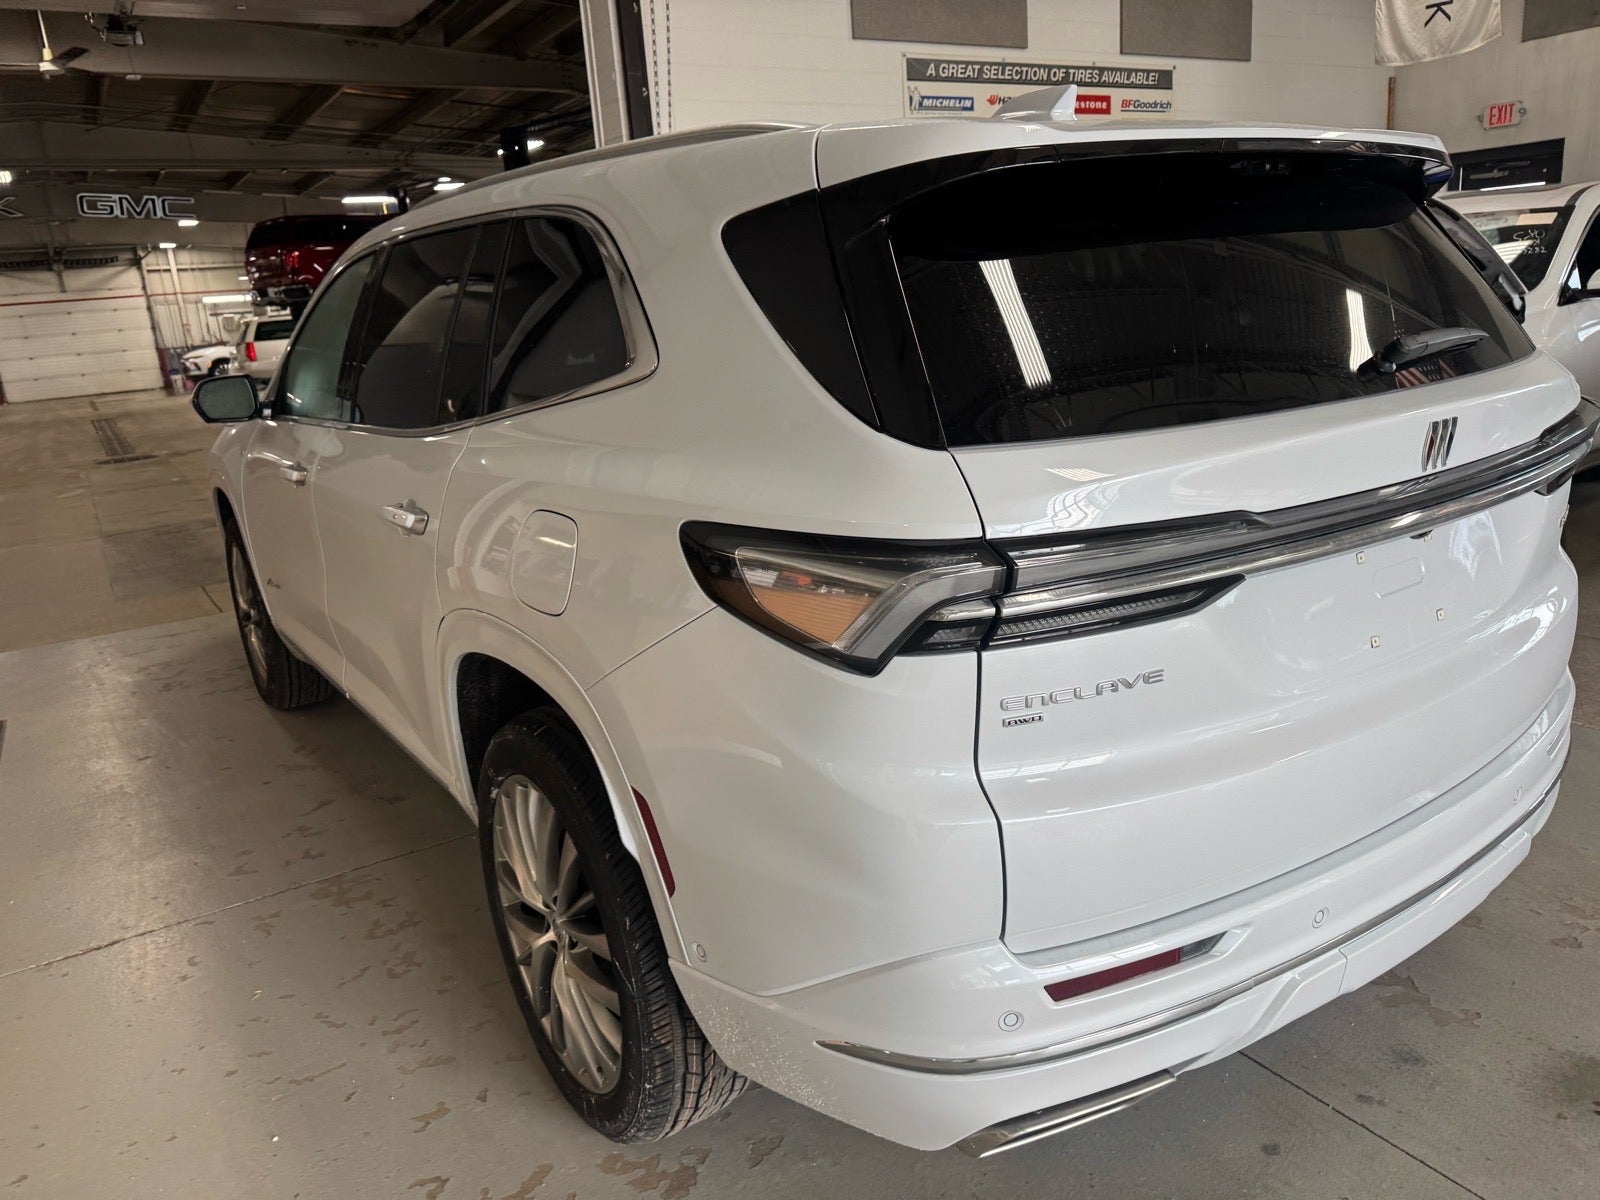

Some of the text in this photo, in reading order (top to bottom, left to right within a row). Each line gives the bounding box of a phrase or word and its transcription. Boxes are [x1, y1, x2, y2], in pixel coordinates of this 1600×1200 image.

[926, 62, 1159, 85] A GREAT SELECTION OF TIRES AVAILABLE!
[922, 98, 973, 108] MICHELIN
[1120, 99, 1172, 110] BFGoodrich
[1488, 103, 1515, 127] EXIT
[76, 192, 196, 220] GMC
[1000, 669, 1165, 712] ENCLAVE
[1004, 713, 1043, 727] AWD
